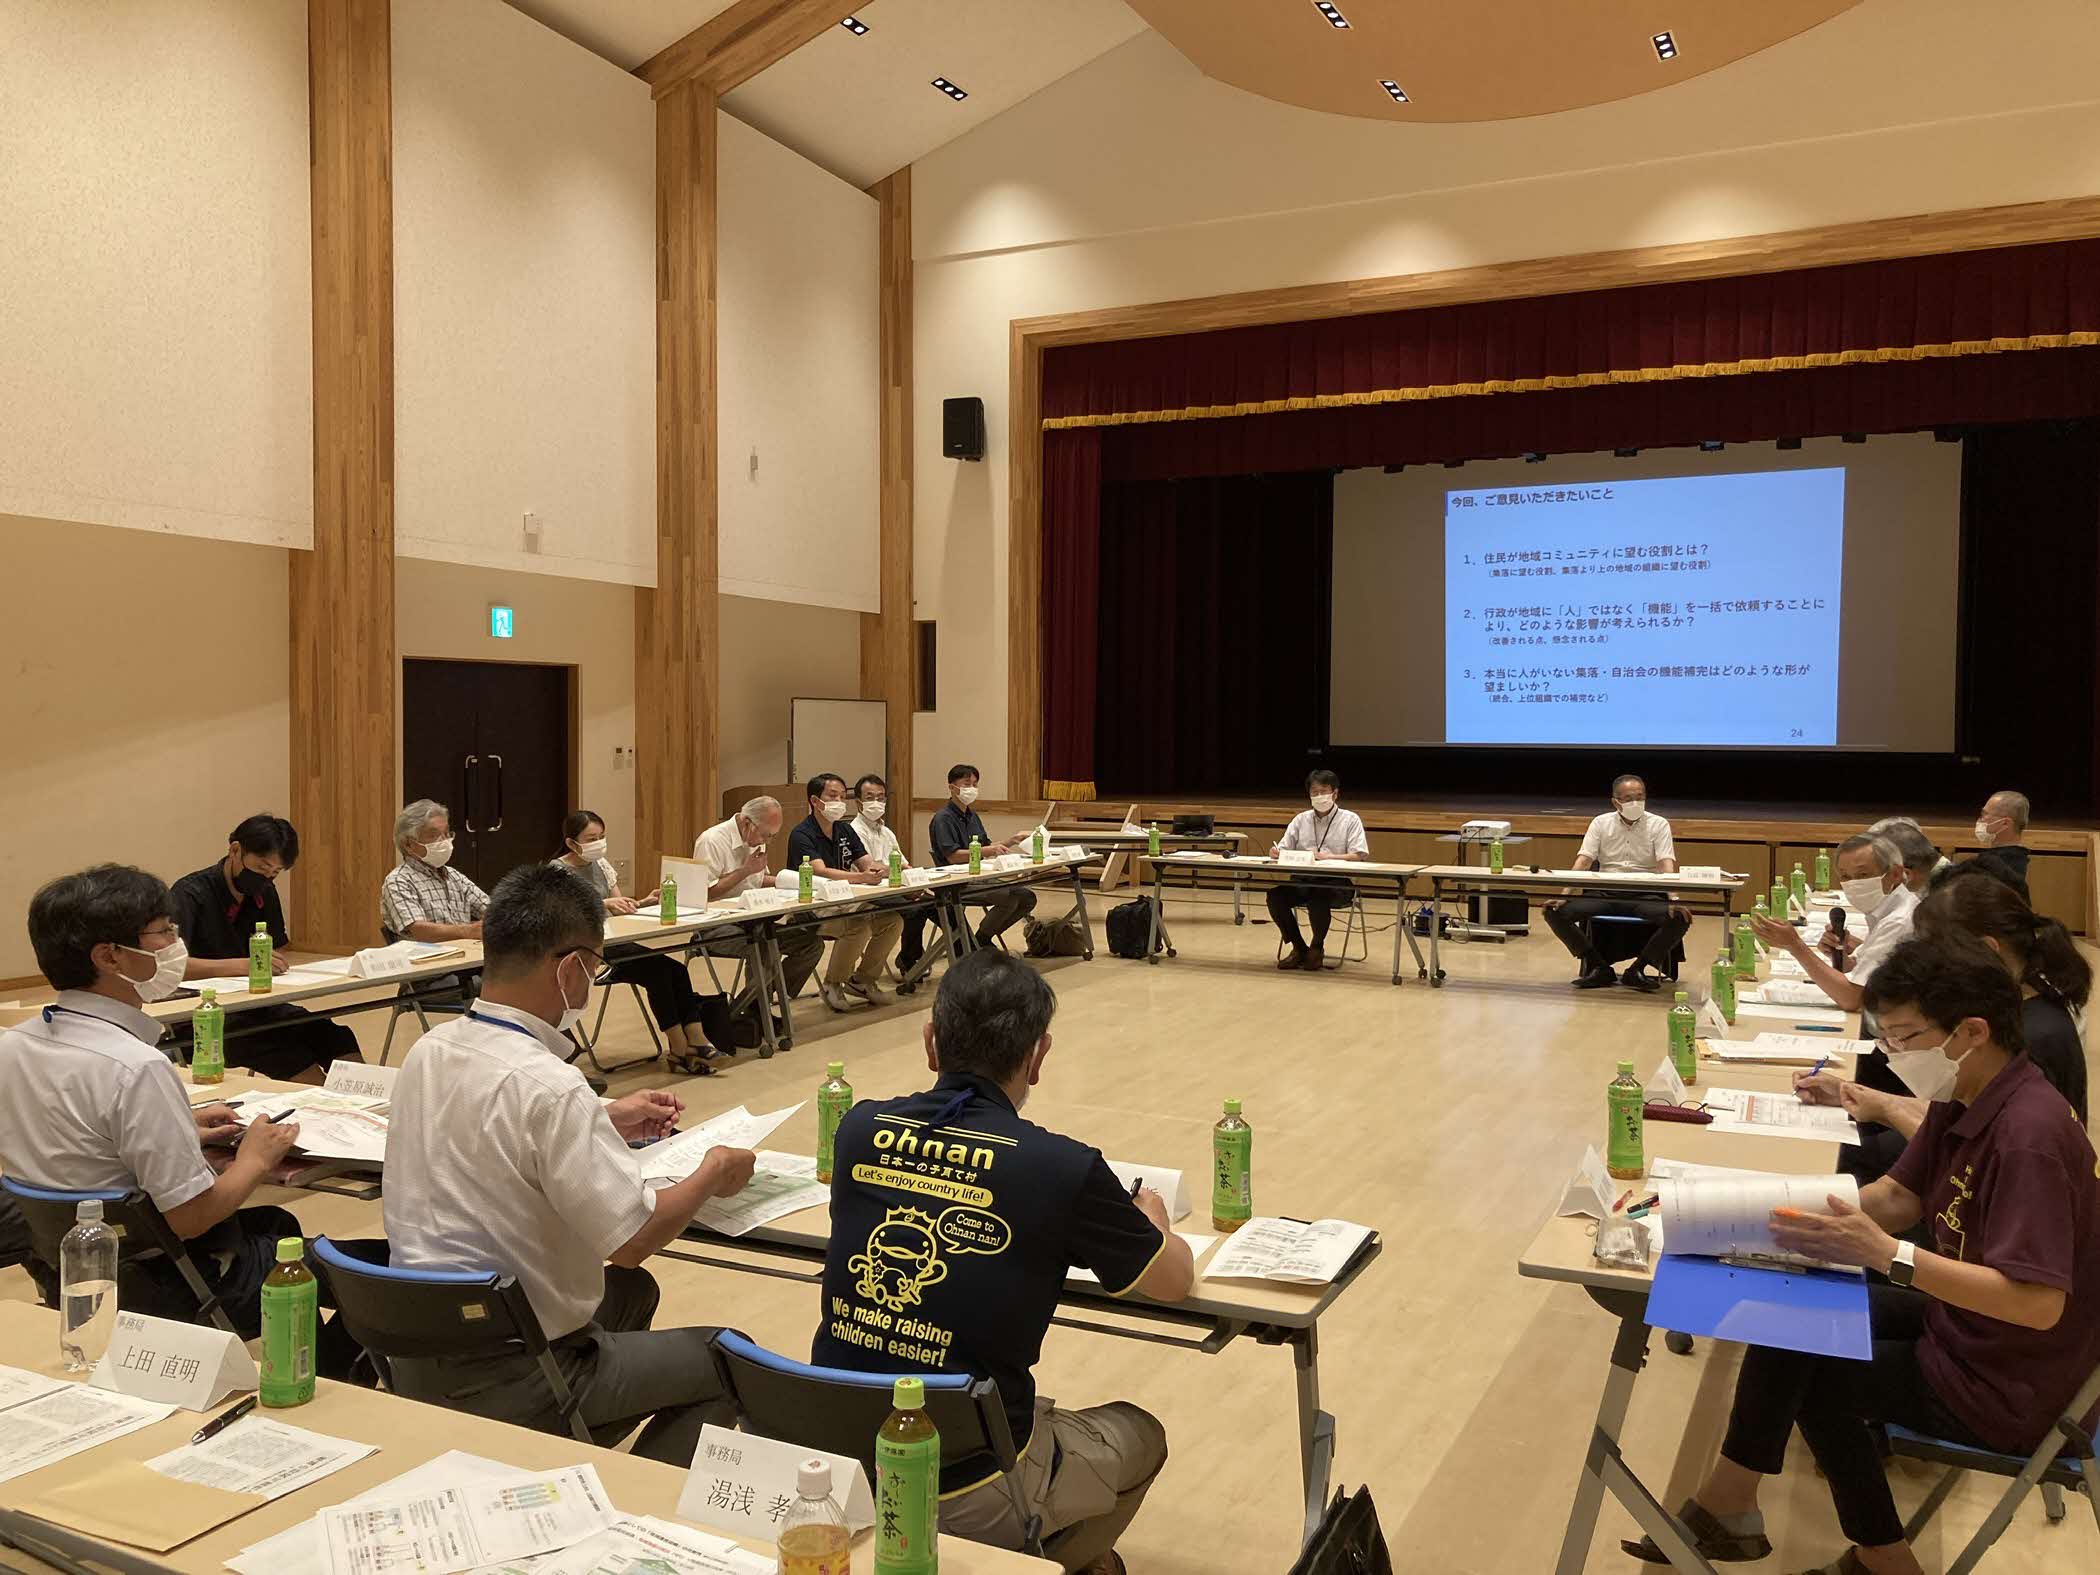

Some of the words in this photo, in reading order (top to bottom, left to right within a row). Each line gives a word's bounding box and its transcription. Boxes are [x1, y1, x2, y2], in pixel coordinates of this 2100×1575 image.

[1451, 488, 1614, 508] 今回、ご意見いただきたいこと
[1791, 728, 1803, 737] 24
[872, 1127, 995, 1170] ohnan
[857, 1166, 884, 1182] Let's
[885, 1172, 916, 1193] enjoy
[917, 1178, 960, 1201] country
[961, 1187, 985, 1204] life!
[879, 1153, 978, 1183] 日本一の子育て村
[944, 1222, 976, 1241] Ohnan
[977, 1232, 1001, 1247] nan!
[956, 1212, 983, 1229] Come
[984, 1221, 995, 1233] to
[832, 1296, 850, 1318] We
[853, 1305, 892, 1330] make
[897, 1317, 953, 1347] raising
[831, 1319, 883, 1352] children
[888, 1338, 946, 1368] easier!
[118, 1345, 156, 1373] 上田
[160, 1354, 201, 1384] 直明
[704, 1442, 743, 1466] 事務局
[707, 1477, 755, 1516] 湯浅
